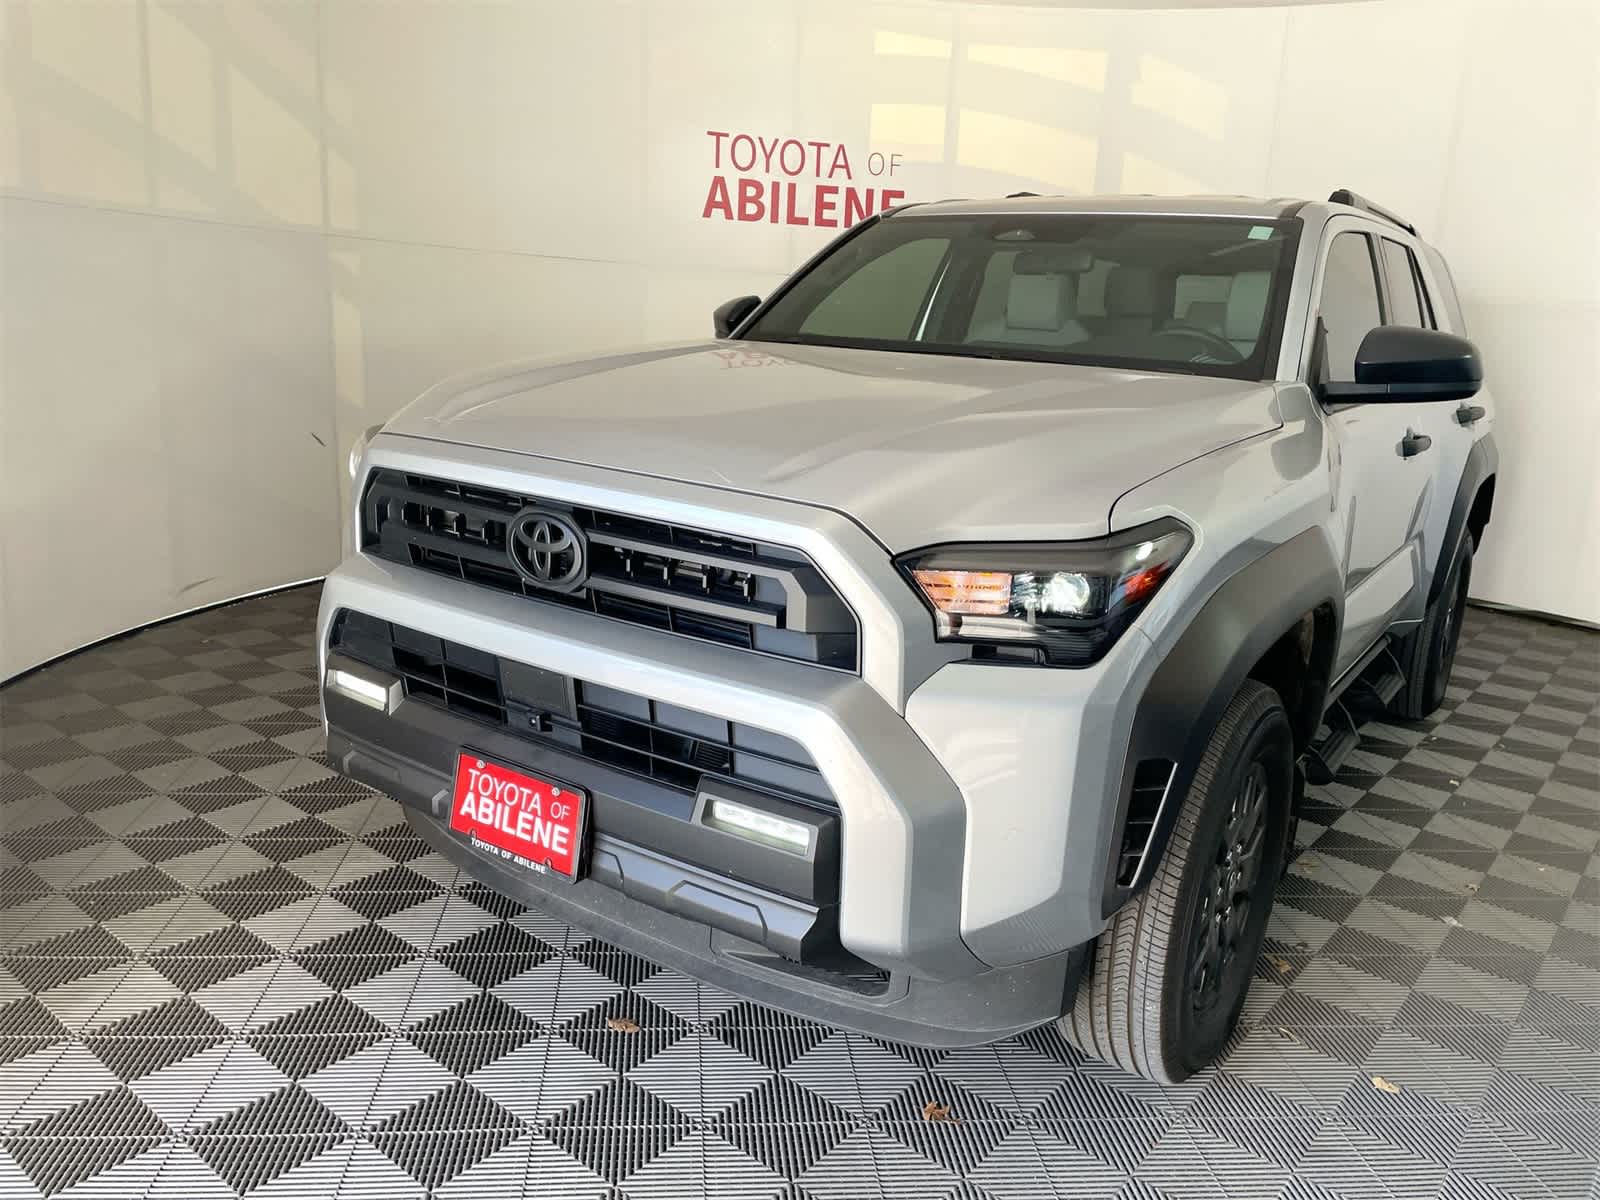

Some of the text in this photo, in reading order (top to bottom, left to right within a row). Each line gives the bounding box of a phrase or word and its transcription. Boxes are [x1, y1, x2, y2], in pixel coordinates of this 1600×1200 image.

[706, 130, 904, 180] TOYOTA OF
[468, 768, 571, 821] TOYOTA OF
[459, 791, 570, 856] ABILENE
[471, 837, 546, 874] TOYOTA OF ABILENE
